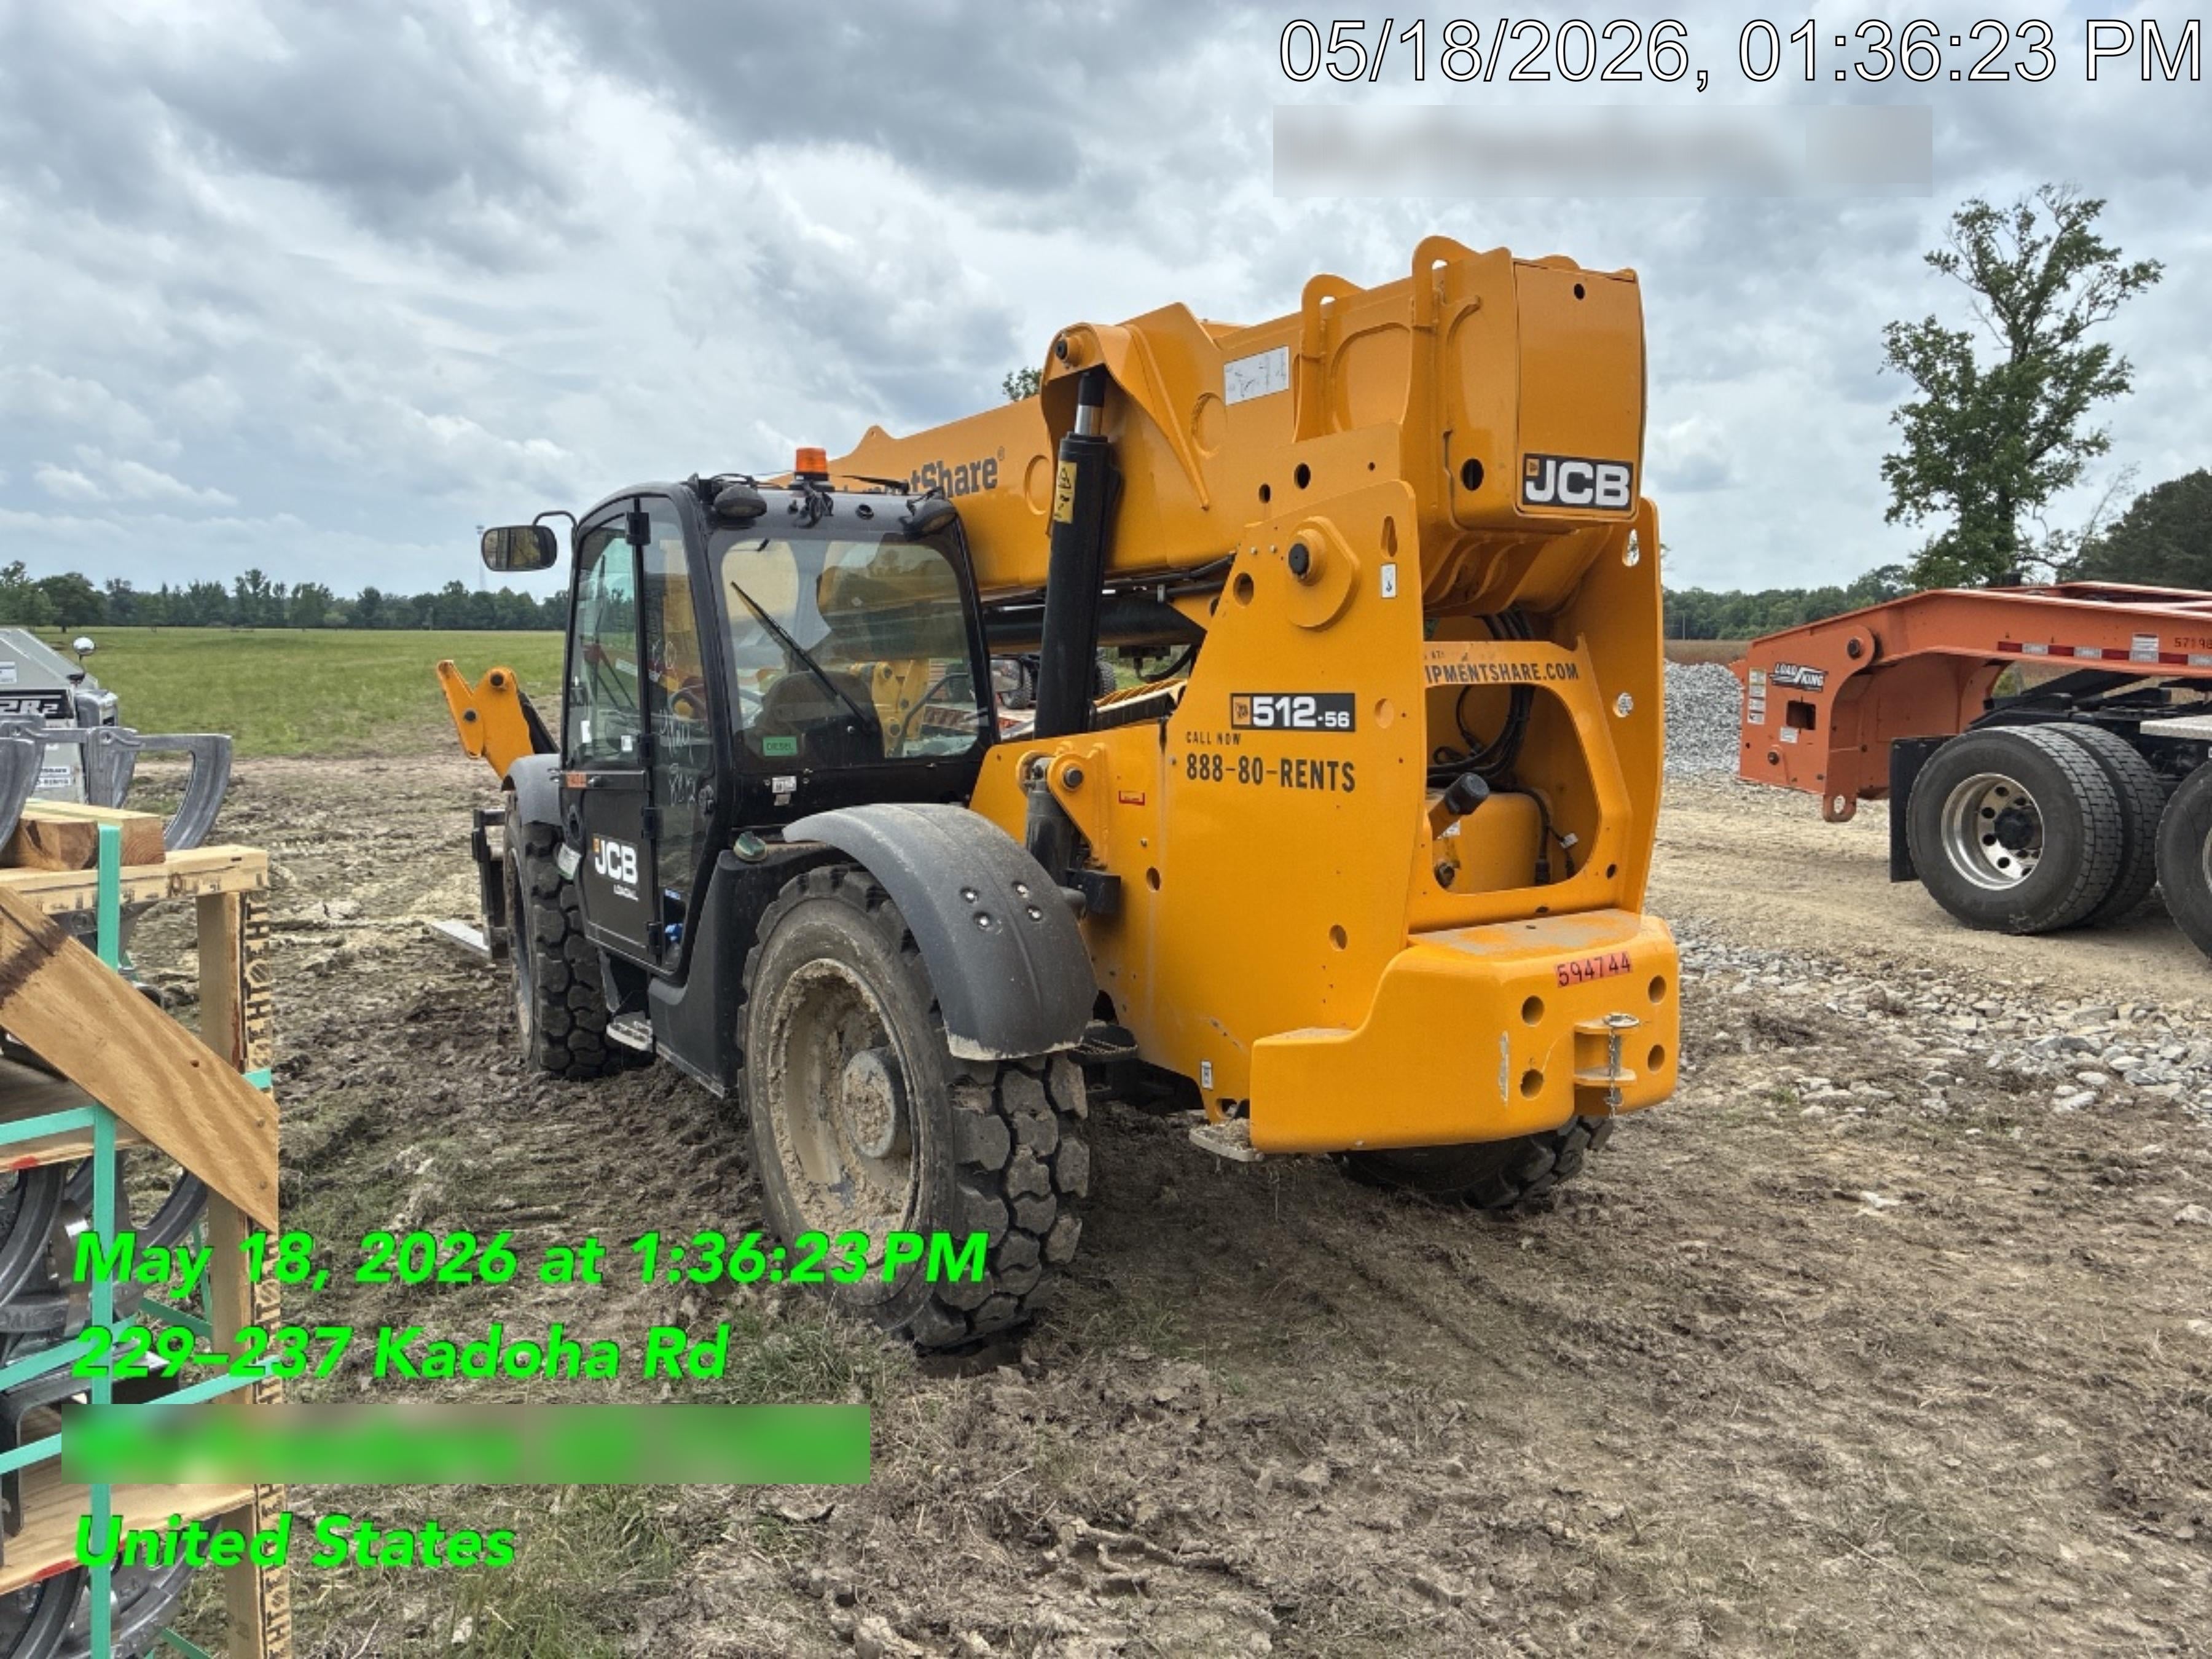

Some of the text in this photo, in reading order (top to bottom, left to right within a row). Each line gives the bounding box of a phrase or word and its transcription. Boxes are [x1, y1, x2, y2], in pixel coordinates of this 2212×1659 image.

[1526, 460, 1630, 506] JCB
[1425, 662, 1579, 683] IPMENTSHARE.COM
[1186, 731, 1241, 745] CALL NOW
[1186, 753, 1355, 793] 888-80-RENTS
[595, 840, 638, 885] JCB
[1557, 952, 1630, 987] 594744
